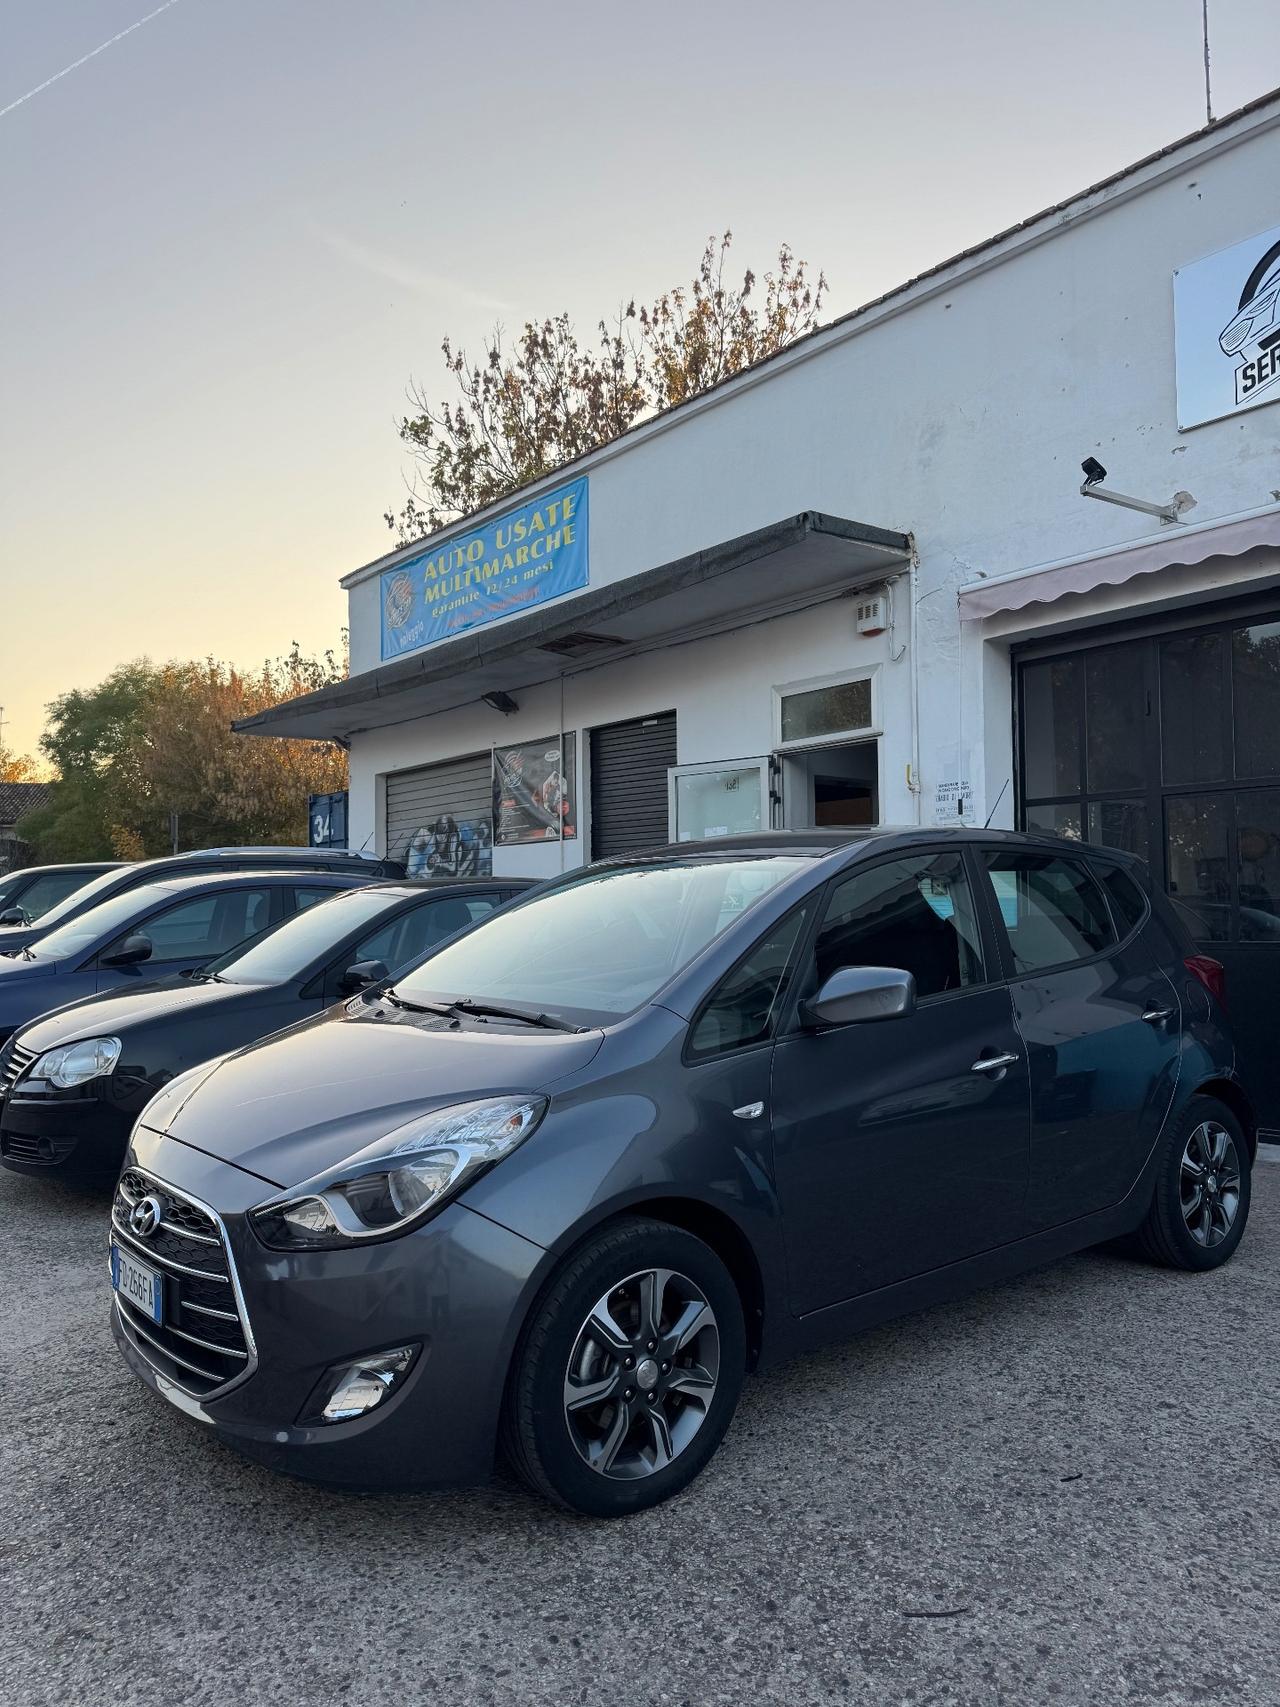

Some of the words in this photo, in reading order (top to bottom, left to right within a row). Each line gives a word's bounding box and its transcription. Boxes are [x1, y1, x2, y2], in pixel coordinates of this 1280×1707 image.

[424, 538, 484, 583] AUTO
[496, 494, 576, 550] USATE
[424, 523, 576, 605] MULTIMARCHE
[523, 559, 553, 581] mesi
[313, 813, 334, 844] 34
